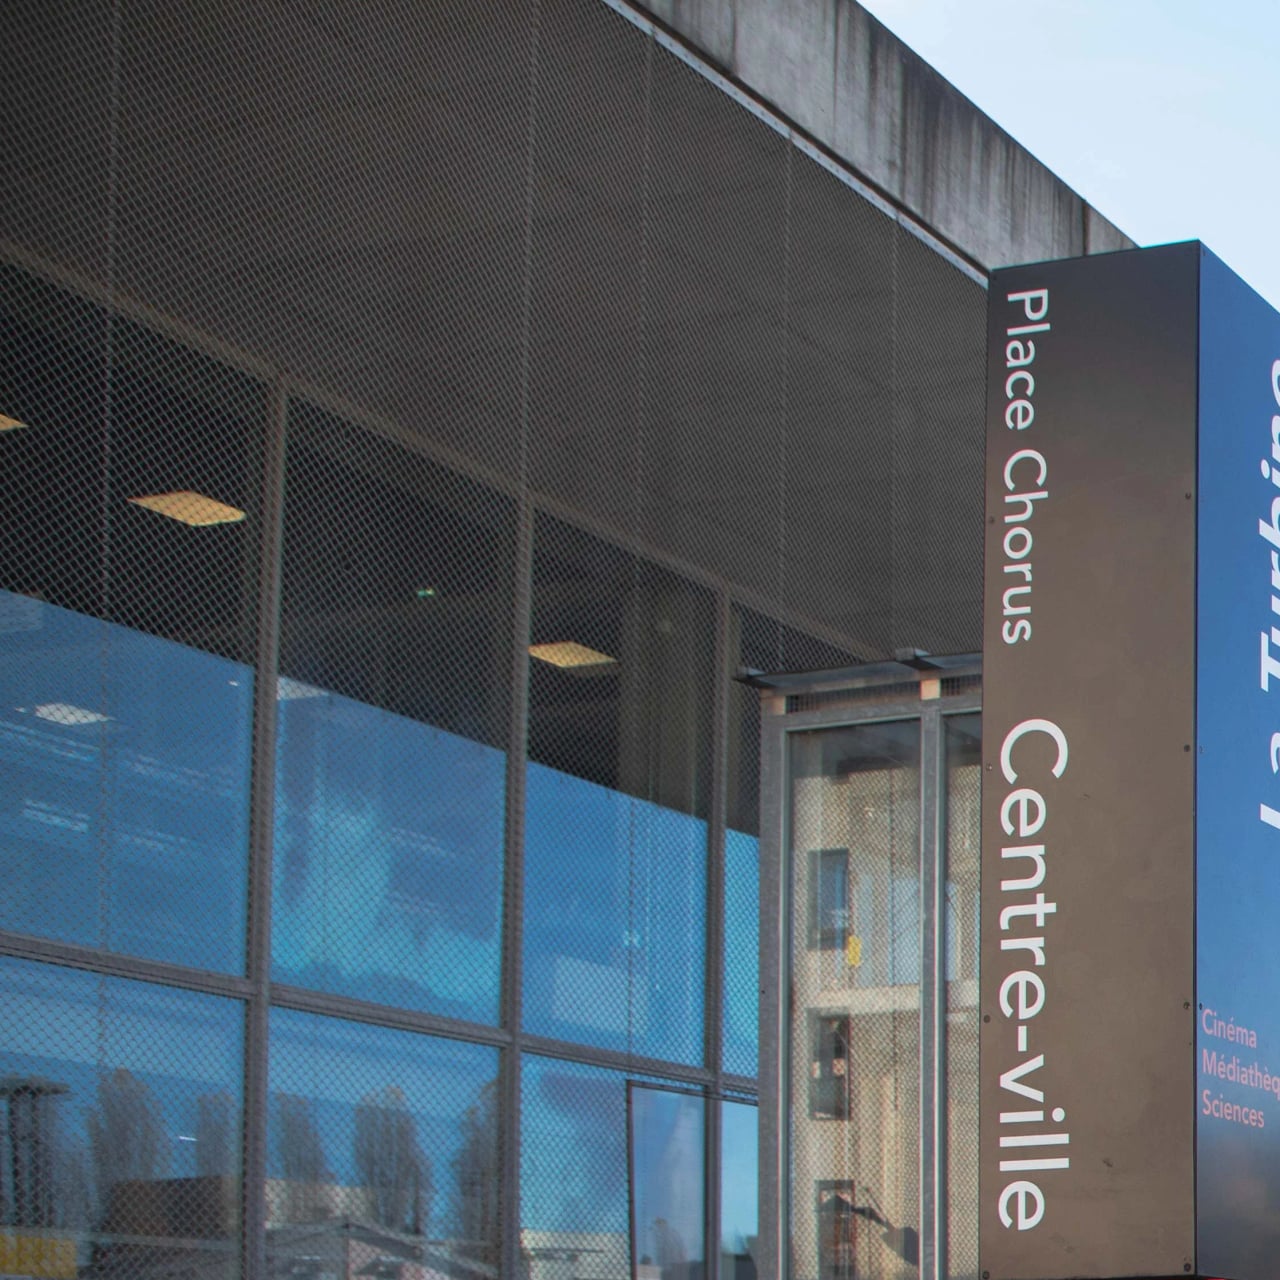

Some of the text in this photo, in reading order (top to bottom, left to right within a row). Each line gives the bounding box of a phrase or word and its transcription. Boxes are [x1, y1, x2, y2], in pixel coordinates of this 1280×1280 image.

[1002, 289, 1050, 644] Place Chorus
[998, 718, 1070, 1231] Centre-ville
[1202, 1009, 1257, 1048] Cinéma
[1202, 1090, 1265, 1128] Sciences
